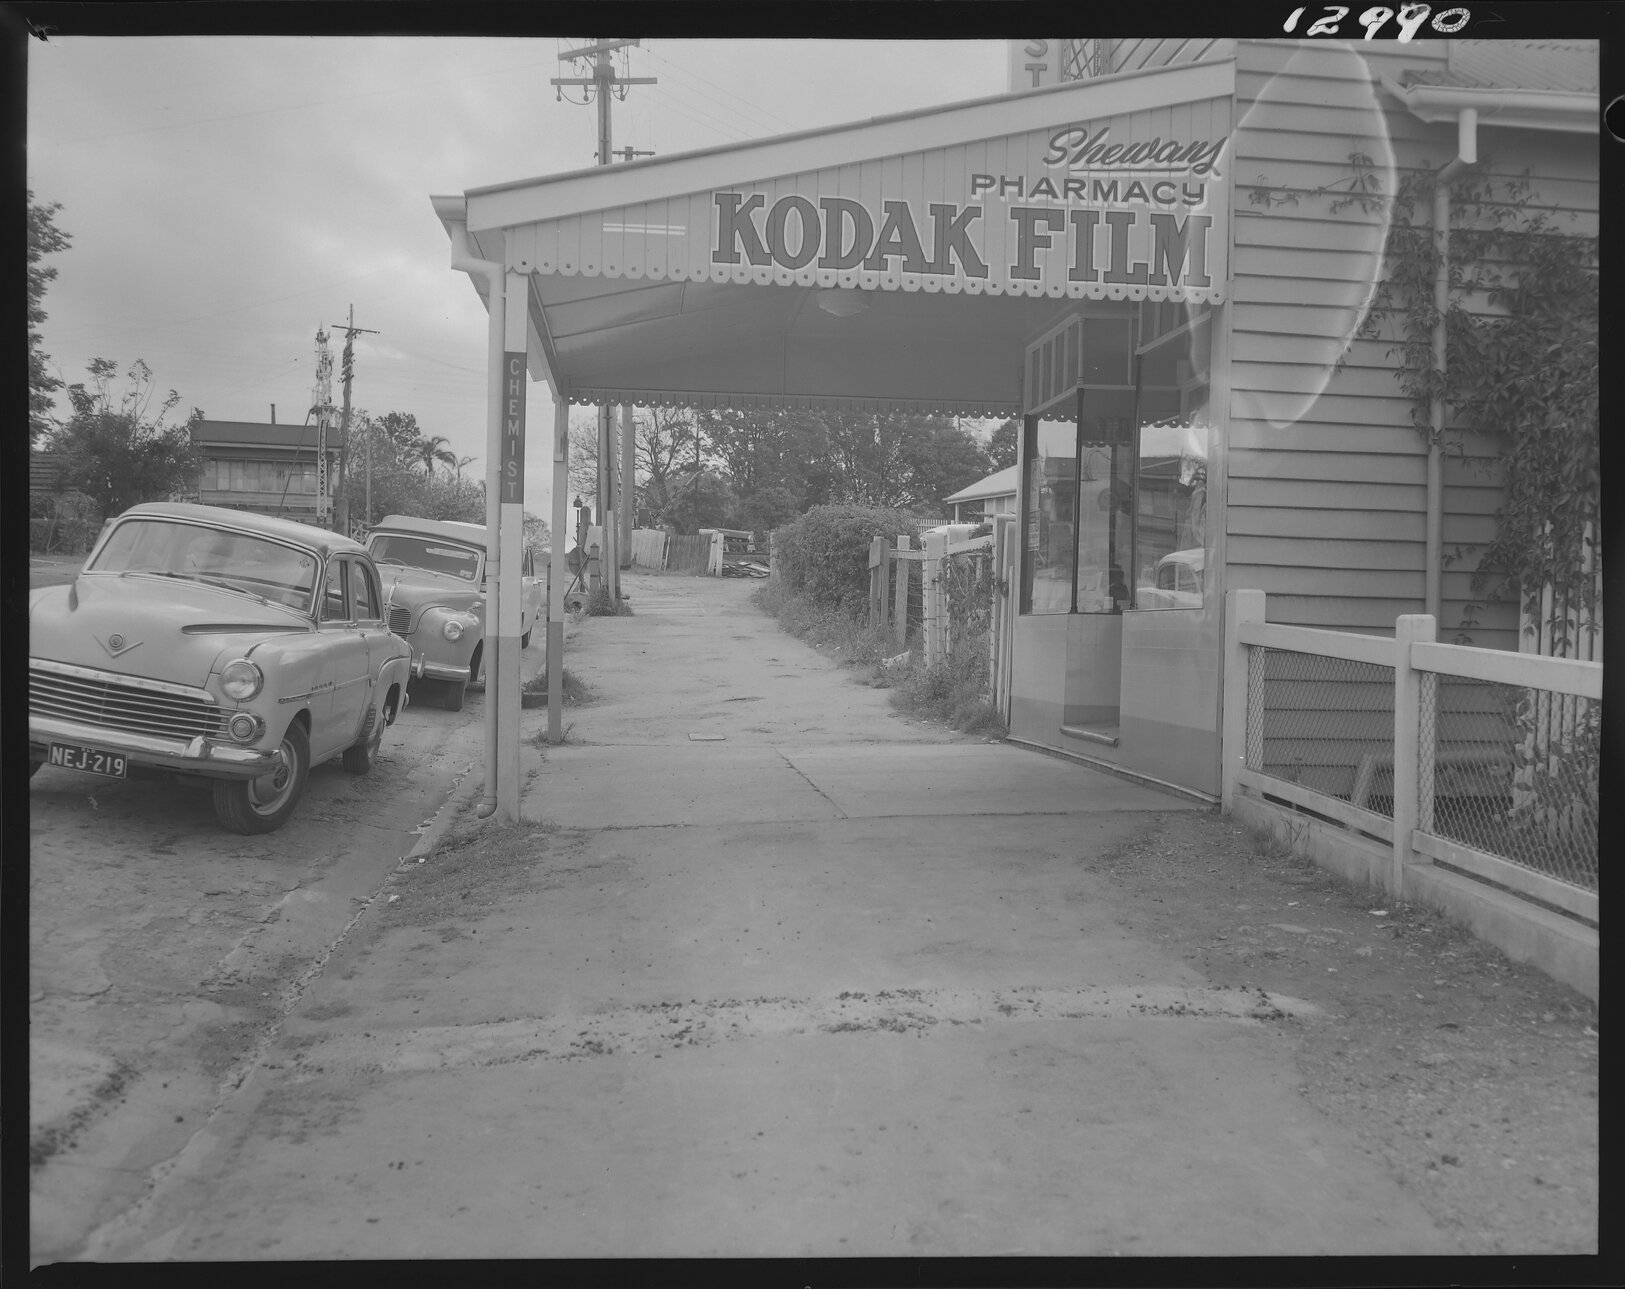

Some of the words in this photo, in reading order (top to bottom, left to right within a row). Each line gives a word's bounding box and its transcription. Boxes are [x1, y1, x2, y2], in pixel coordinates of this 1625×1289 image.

[1283, 4, 1471, 43] 12990
[971, 174, 1205, 207] PHARMACY
[711, 192, 989, 280] KODAK
[1010, 206, 1212, 288] FILM
[508, 358, 520, 499] CHEMIST
[51, 745, 125, 776] NEJ-219
